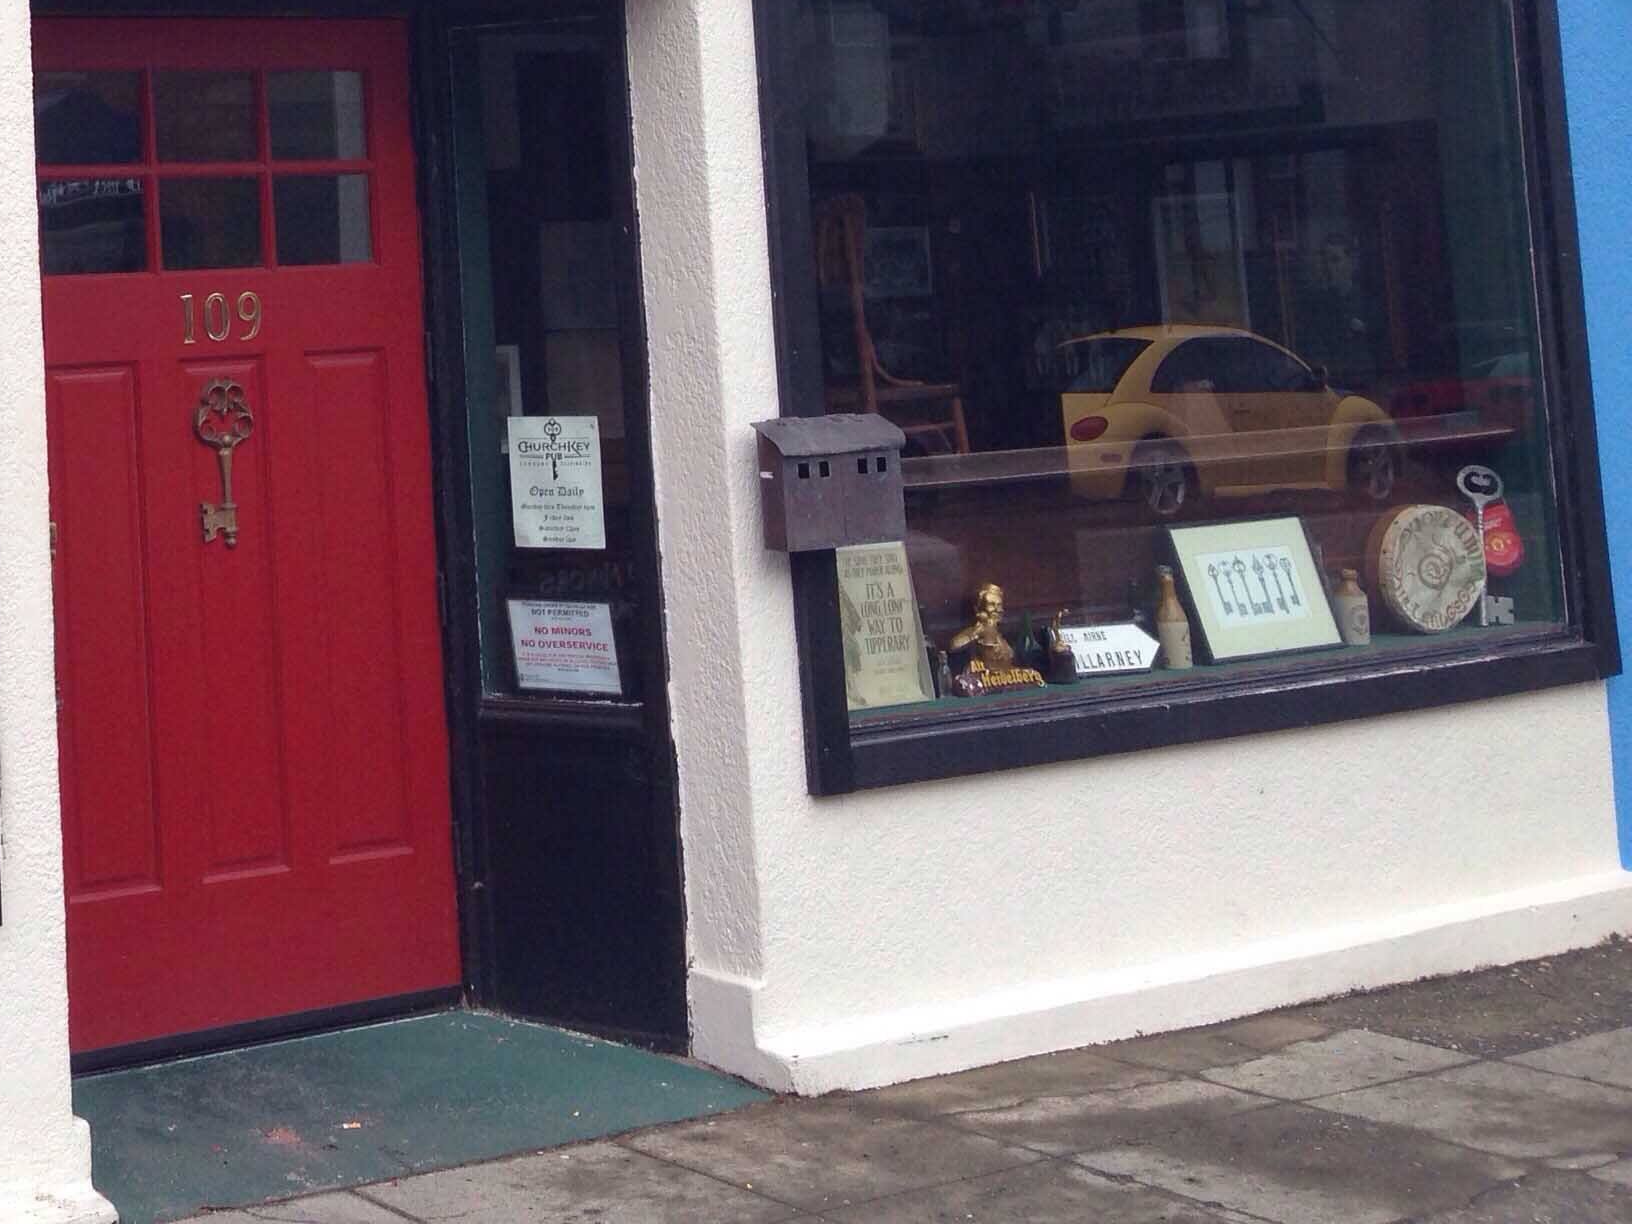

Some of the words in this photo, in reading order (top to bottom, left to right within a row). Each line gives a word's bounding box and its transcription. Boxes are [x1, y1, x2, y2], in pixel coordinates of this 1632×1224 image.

[179, 291, 263, 344] 109
[545, 453, 563, 461] PUB
[529, 485, 555, 498] Open
[556, 485, 585, 497] Daily
[887, 582, 895, 598] A
[531, 608, 546, 617] NOT
[547, 608, 590, 618] PERMITTED
[534, 626, 548, 635] NO
[551, 626, 592, 637] MINORS
[867, 618, 886, 634] WAY
[889, 617, 904, 633] TO
[520, 639, 536, 648] NO
[538, 640, 609, 652] OVERSERVICE
[864, 635, 911, 655] TIPPERARY
[1075, 649, 1143, 670] ILLARNEY
